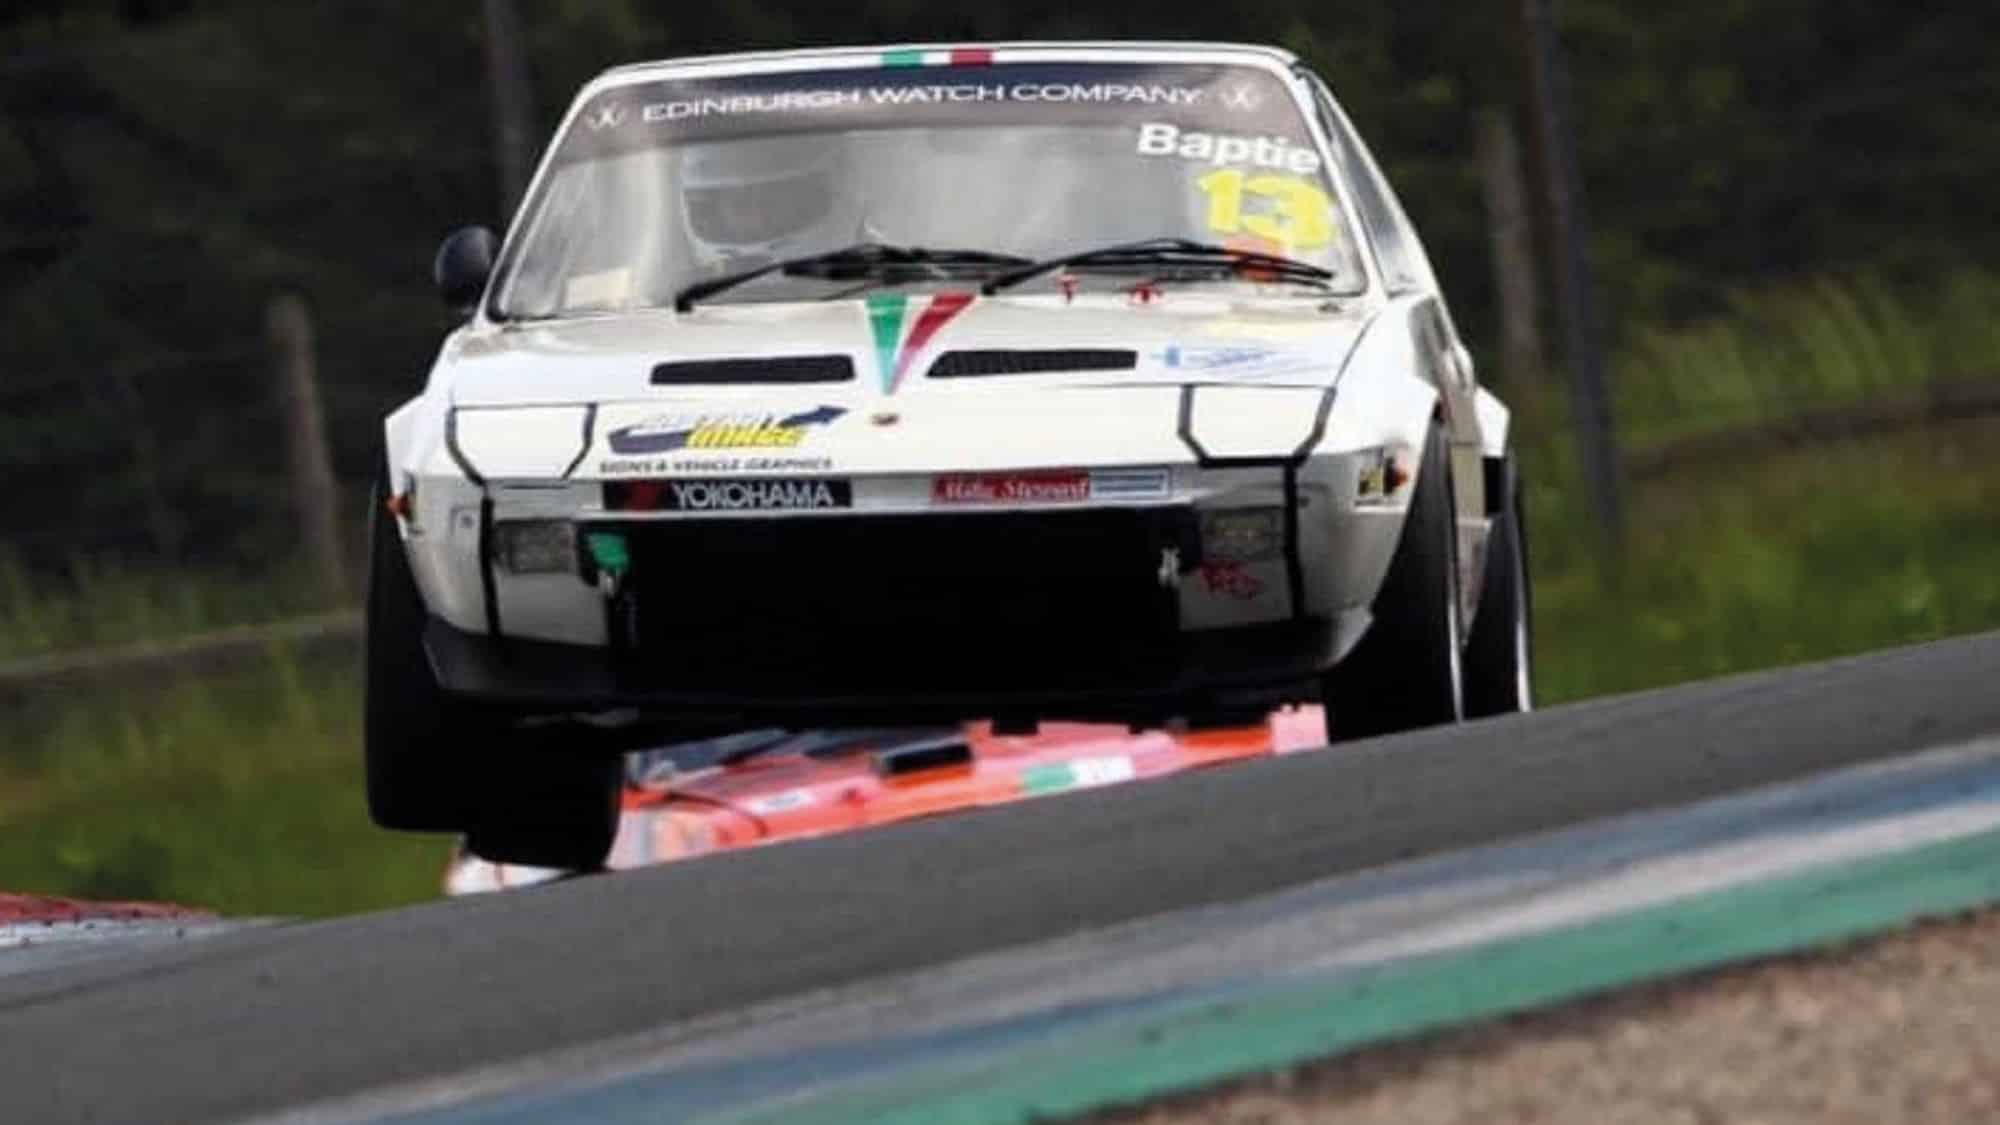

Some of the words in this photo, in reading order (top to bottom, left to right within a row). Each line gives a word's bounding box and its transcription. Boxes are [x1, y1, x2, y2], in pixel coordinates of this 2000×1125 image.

[642, 90, 861, 121] EDINBURGH
[868, 84, 1003, 106] WATCH
[1011, 84, 1203, 107] COMPANY
[1137, 122, 1321, 174] Baptie
[1199, 169, 1336, 249] 13
[671, 481, 835, 510] YOKOHAMA
